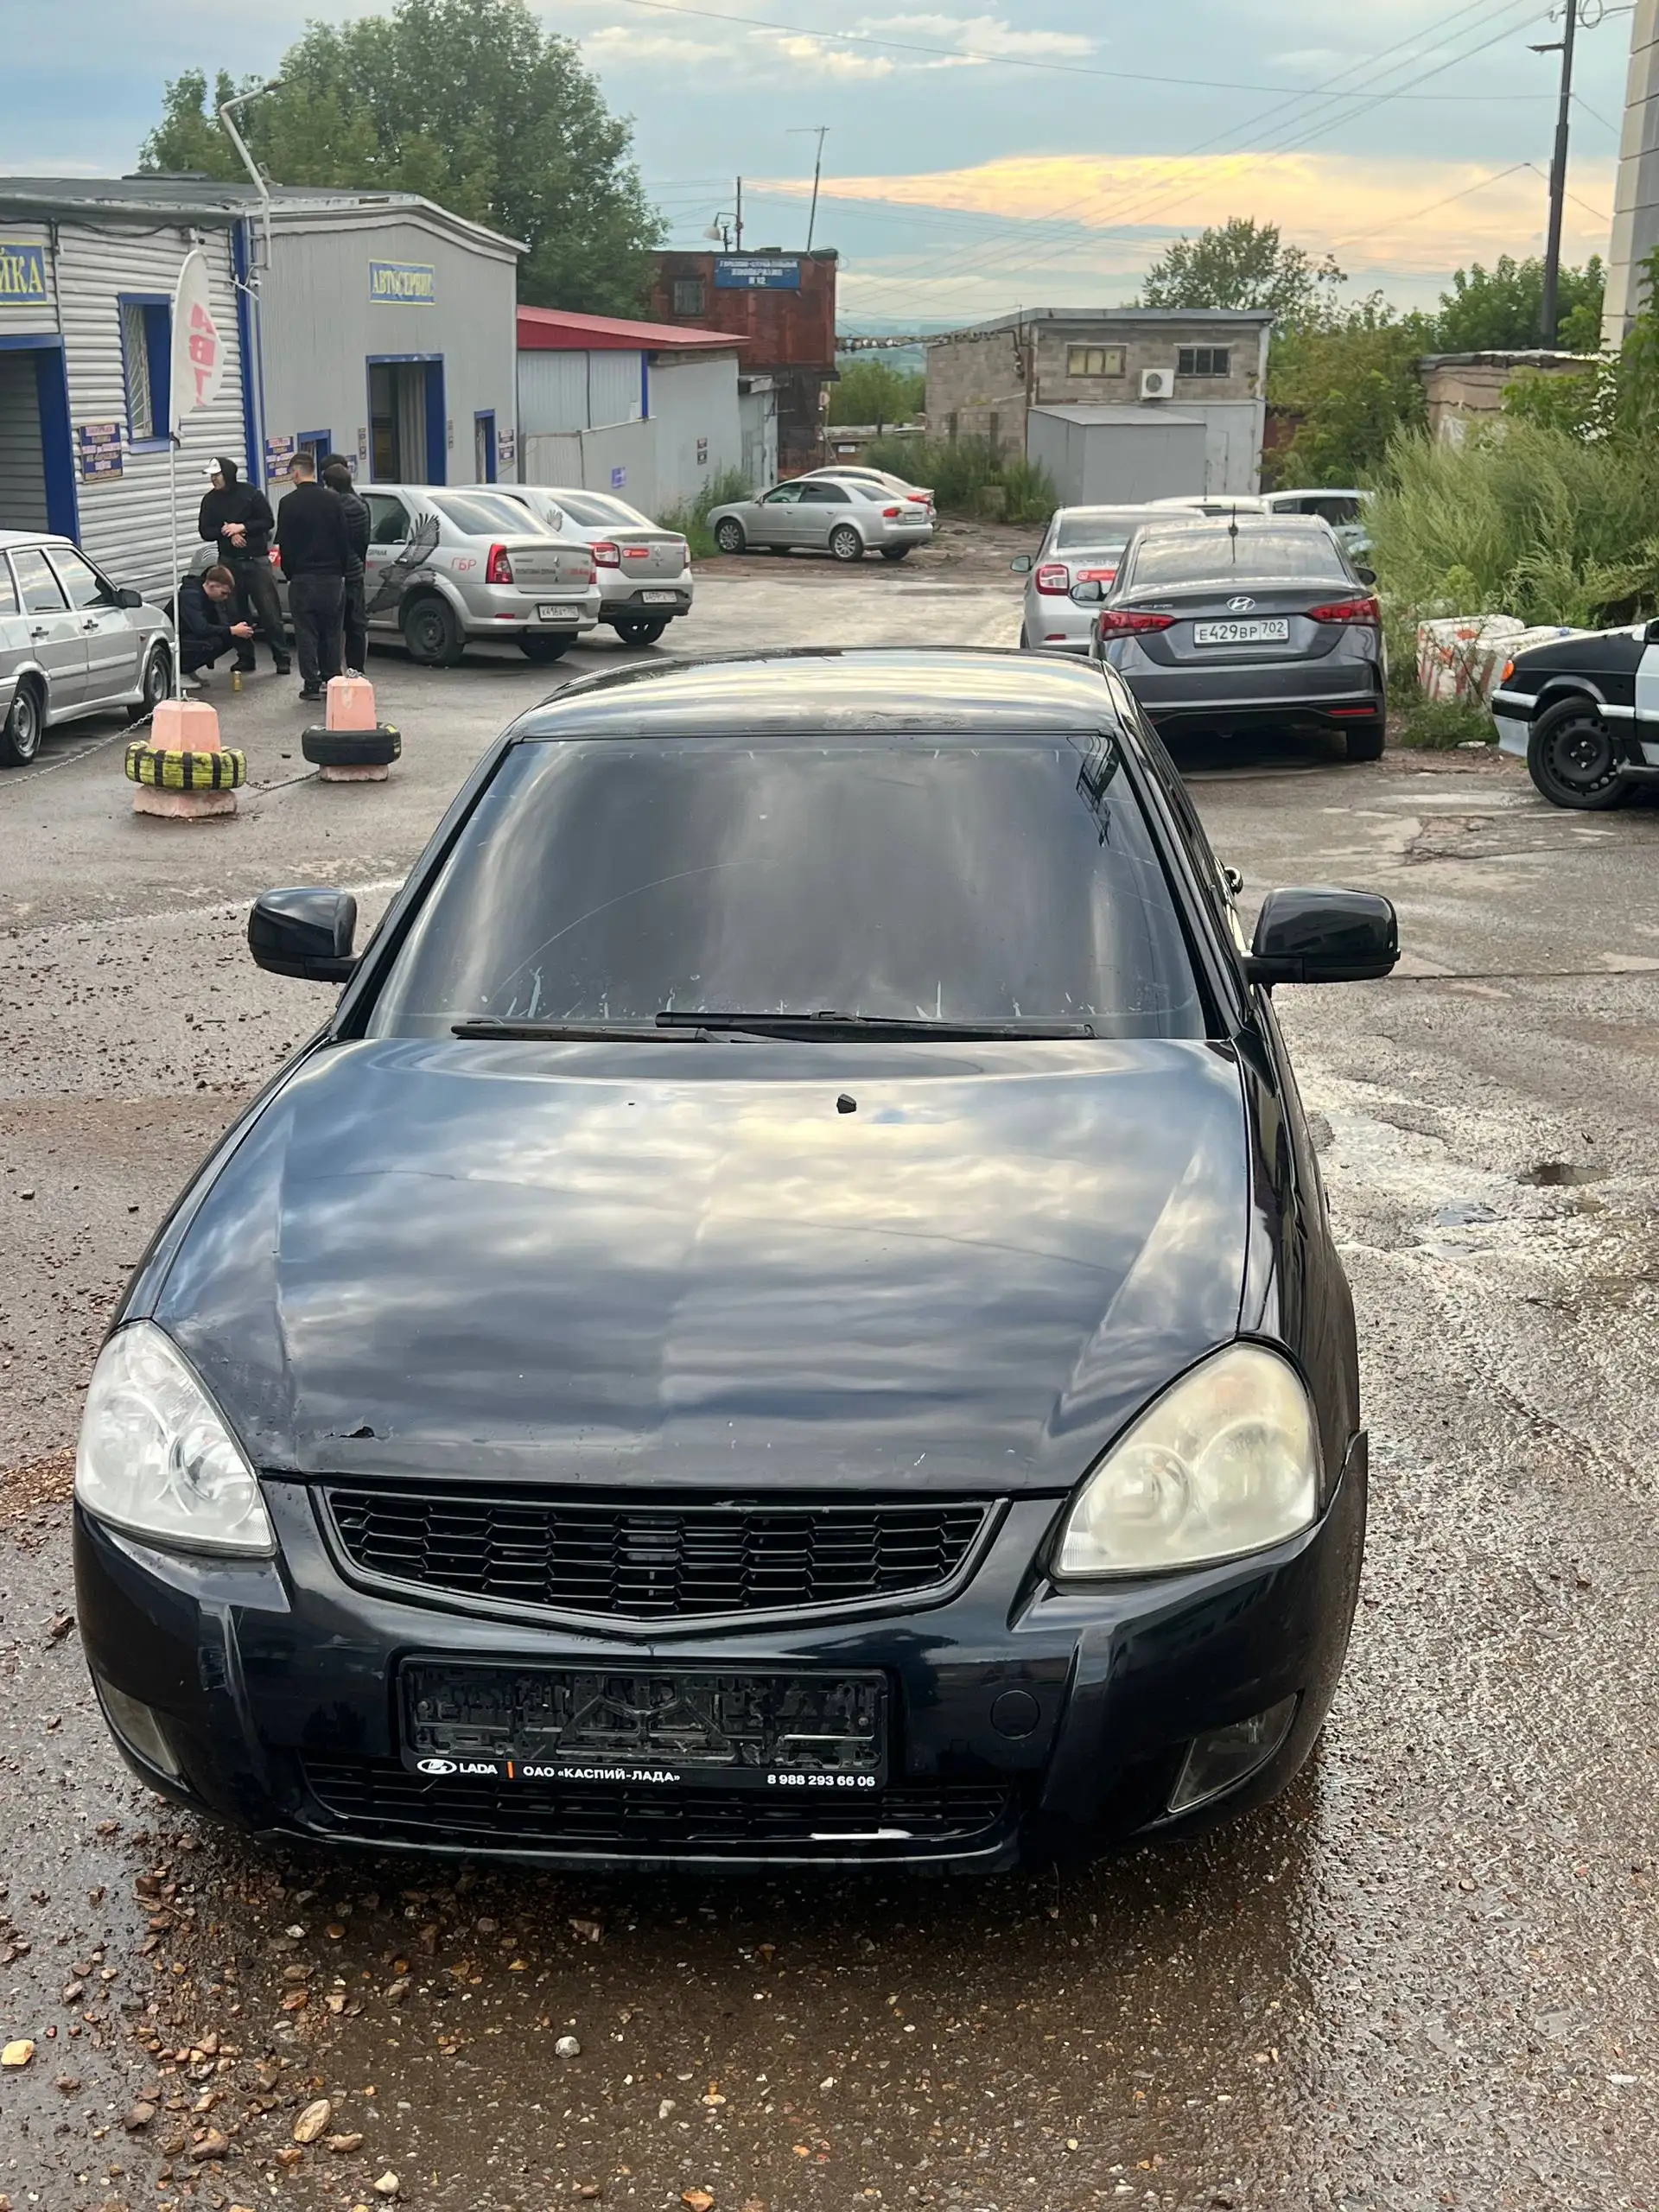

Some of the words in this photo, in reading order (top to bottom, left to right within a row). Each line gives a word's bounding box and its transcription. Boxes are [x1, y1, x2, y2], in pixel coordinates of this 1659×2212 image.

[451, 557, 477, 571] ГБР
[1199, 624, 1258, 640] Е429ВР
[1262, 622, 1284, 633] 702
[459, 1762, 498, 1775] LADA
[523, 1765, 555, 1777] ОАО
[557, 1767, 680, 1783] «КАСПИЙ-ЛАДА»
[767, 1774, 777, 1784] 8
[779, 1774, 805, 1785] 988
[808, 1775, 835, 1786] 293
[836, 1776, 855, 1786] 66
[857, 1776, 875, 1787] 06
